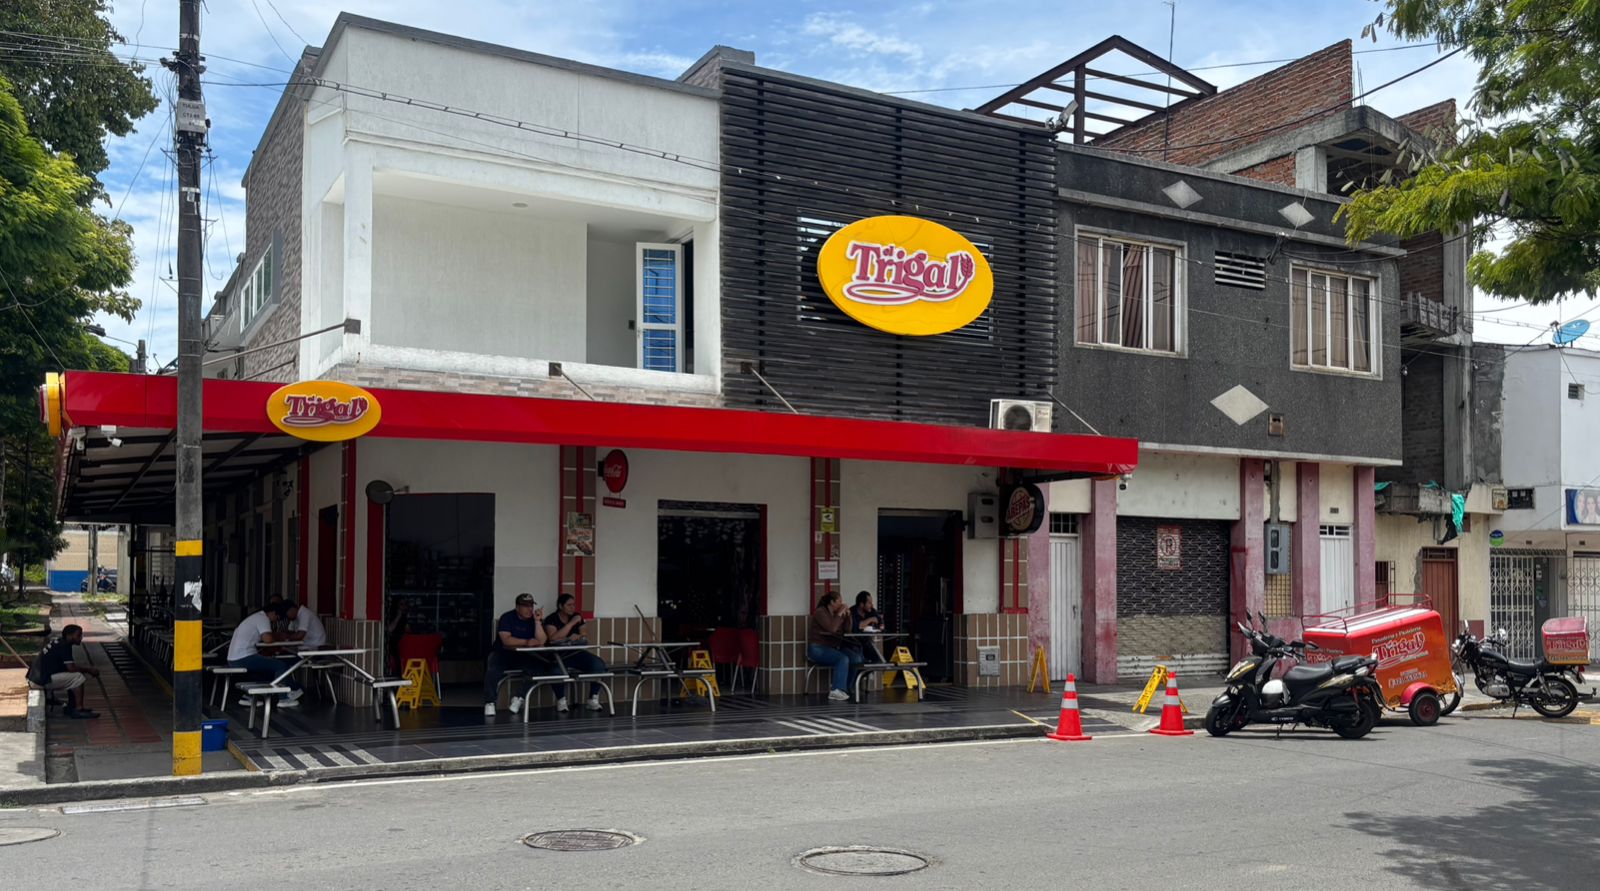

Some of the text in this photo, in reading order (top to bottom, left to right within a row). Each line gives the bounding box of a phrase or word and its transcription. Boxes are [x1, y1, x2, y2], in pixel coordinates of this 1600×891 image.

[848, 243, 974, 300] Trigal
[285, 395, 367, 422] Trigal
[1372, 632, 1425, 662] Trigal
